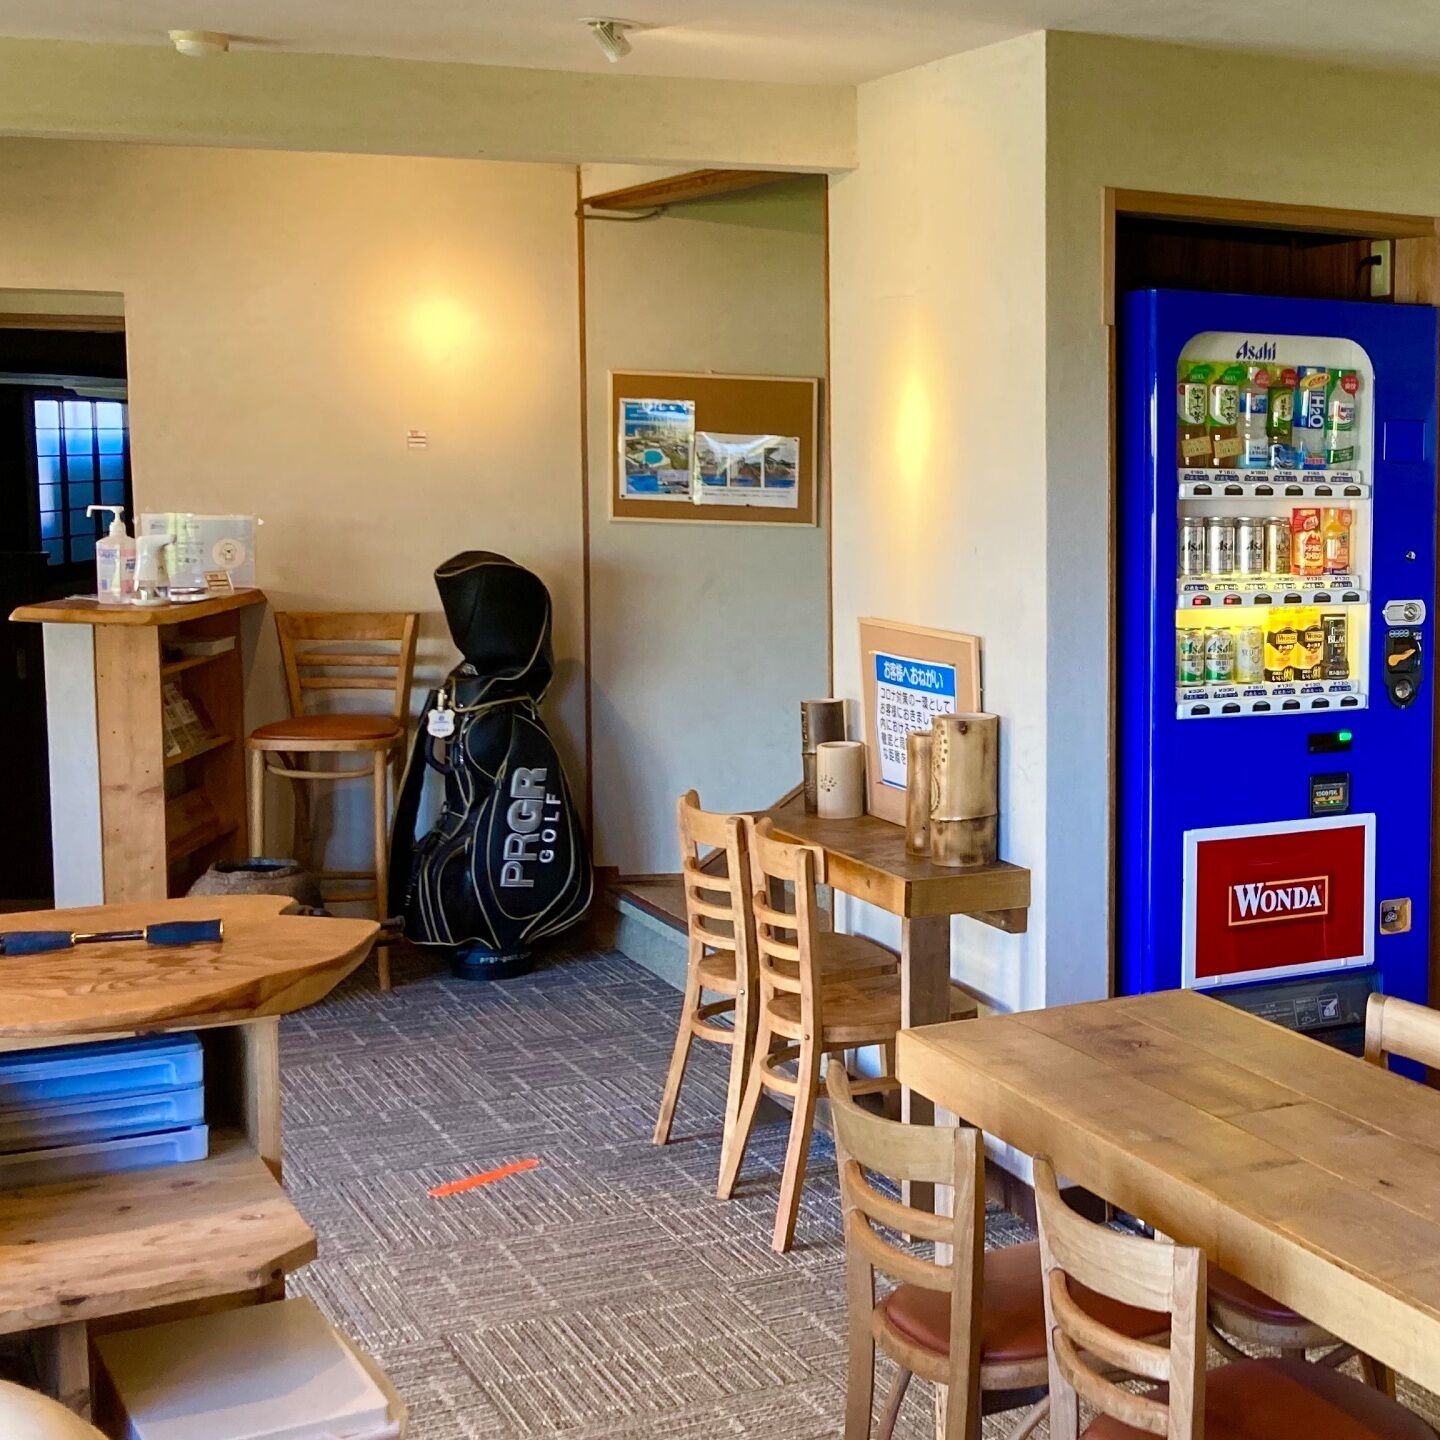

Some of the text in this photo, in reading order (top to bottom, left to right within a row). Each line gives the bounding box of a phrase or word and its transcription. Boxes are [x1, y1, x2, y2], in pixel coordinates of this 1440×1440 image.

[1235, 340, 1277, 361] Asahi
[884, 661, 944, 689] お客様へおねがい
[879, 703, 938, 726] お客様におきまし
[880, 687, 952, 714] コロナ対策の一環として
[500, 767, 548, 888] PRGR
[538, 792, 562, 864] GOLF
[1233, 882, 1322, 918] WONDA
